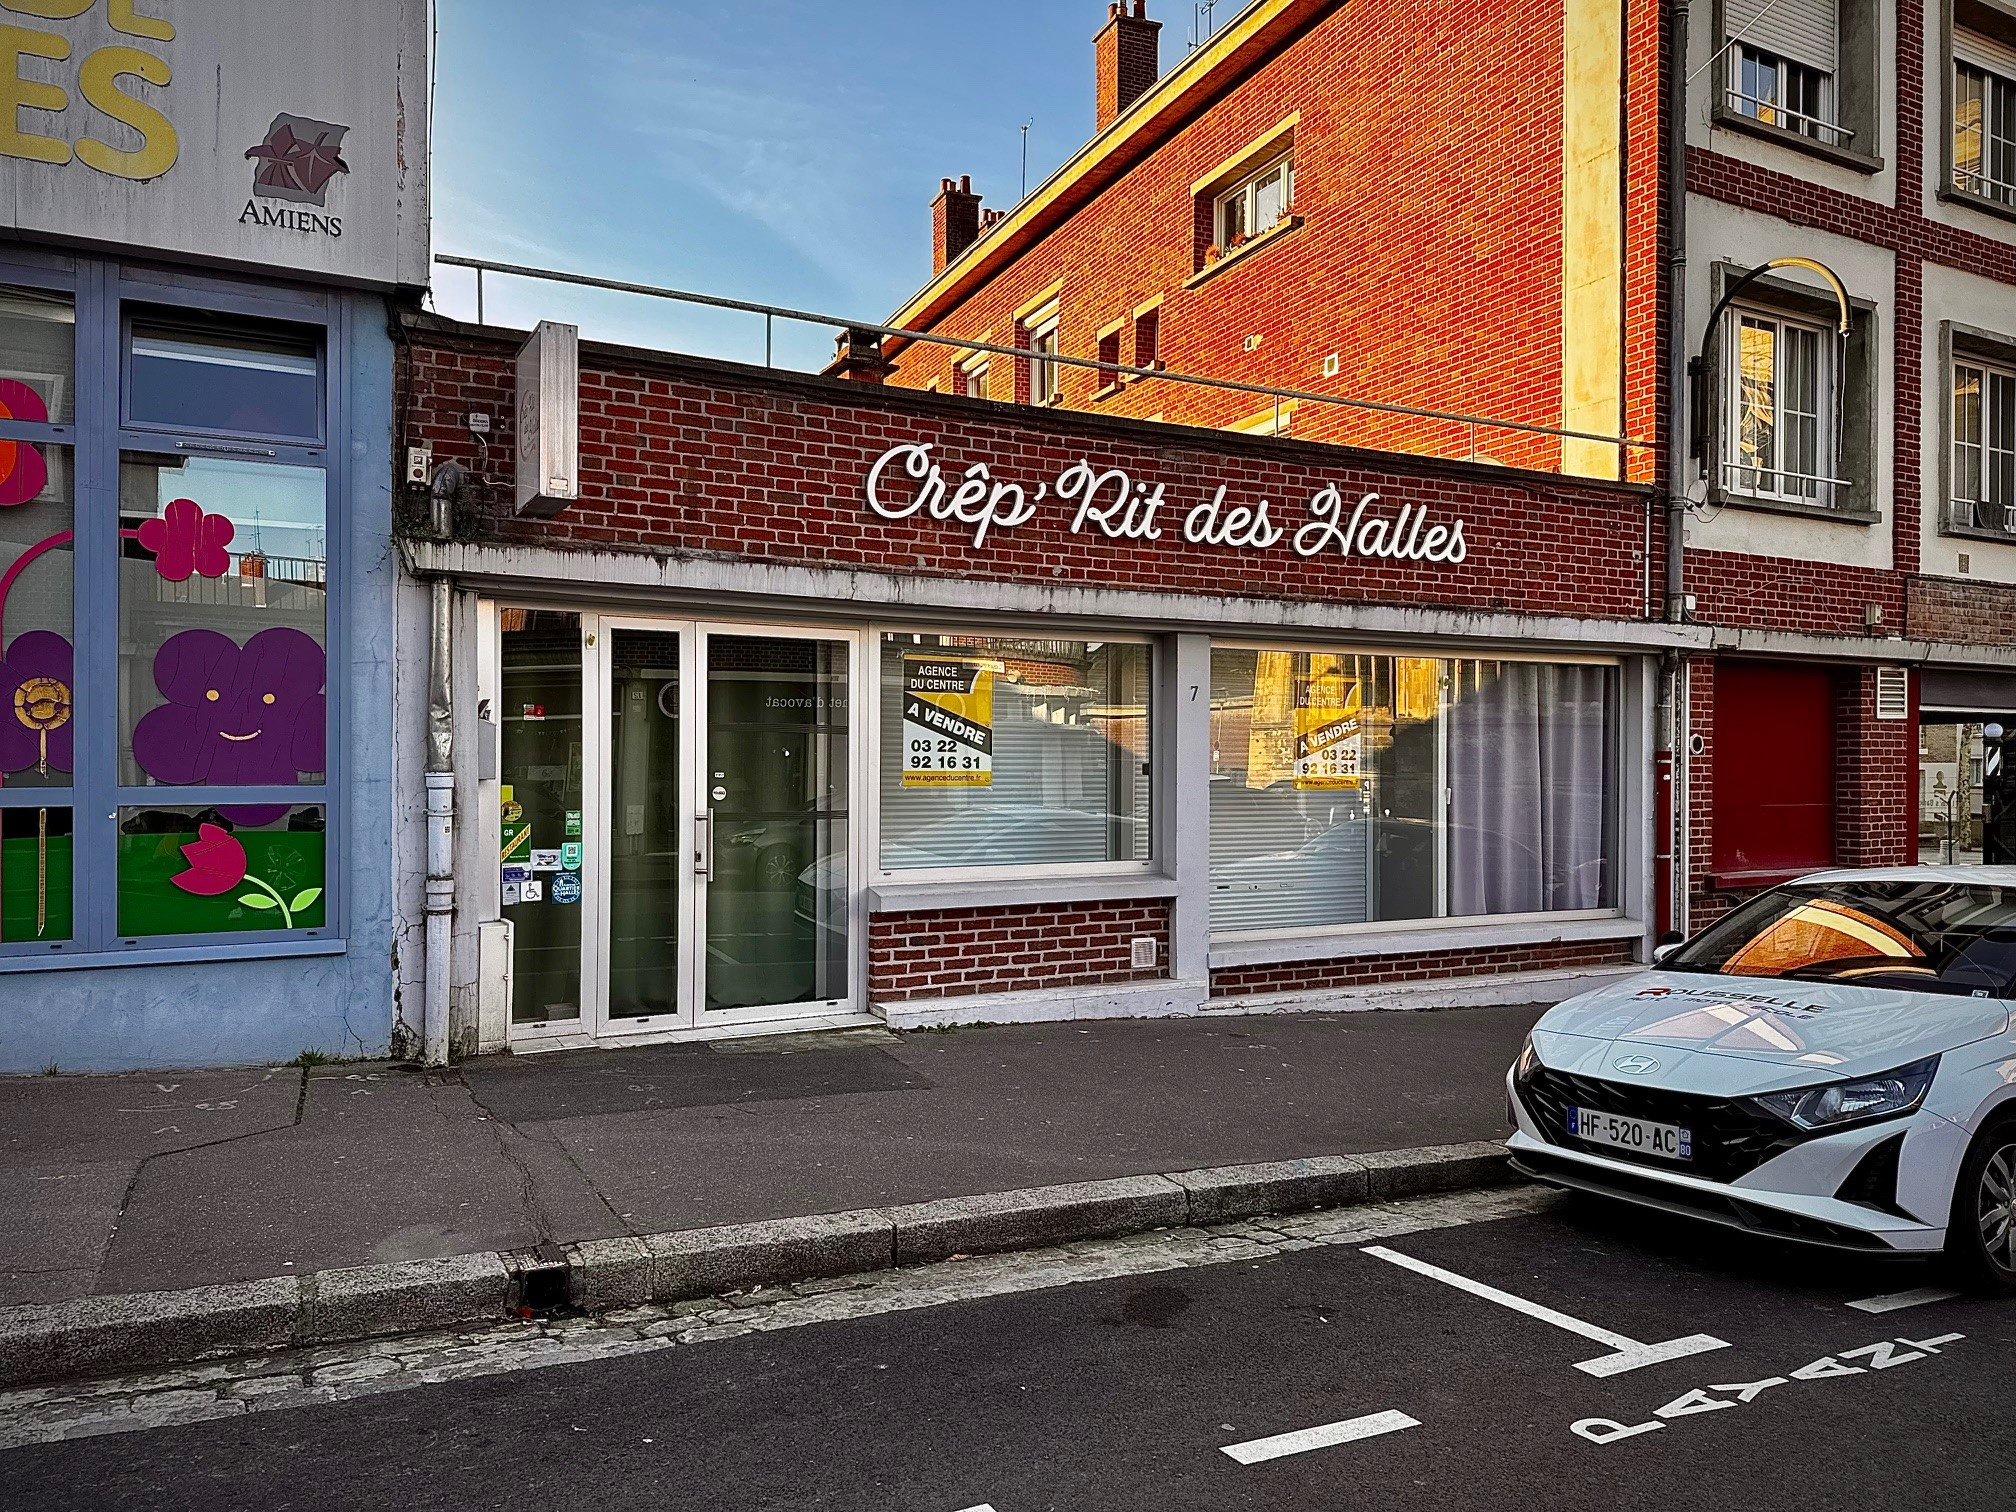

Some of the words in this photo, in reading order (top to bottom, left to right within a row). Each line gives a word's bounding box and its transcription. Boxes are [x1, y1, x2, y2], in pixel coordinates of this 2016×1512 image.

[239, 200, 343, 237] AMIENS
[1184, 485, 1284, 547] des
[1294, 482, 1469, 564] Halles
[918, 665, 958, 677] AGENCE
[910, 679, 924, 689] DU
[926, 680, 965, 691] CENTRE
[1305, 685, 1336, 695] AGENCE
[1190, 686, 1199, 702] 7
[1299, 696, 1310, 706] DU
[1311, 697, 1341, 707] CENTRE
[907, 703, 919, 717] A
[924, 708, 986, 746] VENDRE
[1300, 741, 1310, 754] A
[1309, 718, 1359, 748] VENDRE
[911, 739, 932, 753] 03
[937, 740, 958, 753] 22
[911, 755, 932, 769] 92
[937, 756, 957, 769] 16
[962, 756, 981, 769] 31
[1321, 749, 1338, 761] 03
[1341, 749, 1357, 761] 22
[1302, 763, 1318, 775] 92
[1322, 763, 1337, 775] 16
[1341, 763, 1355, 774] 31
[905, 774, 982, 783] www.agenceducentre.fr
[503, 829, 514, 837] GR
[1636, 987, 1830, 1014] ROUSSELLE
[1580, 1111, 1676, 1154] HF-520-AC
[1680, 1144, 1691, 1156] 80
[1570, 1333, 1966, 1445] PAYANT
